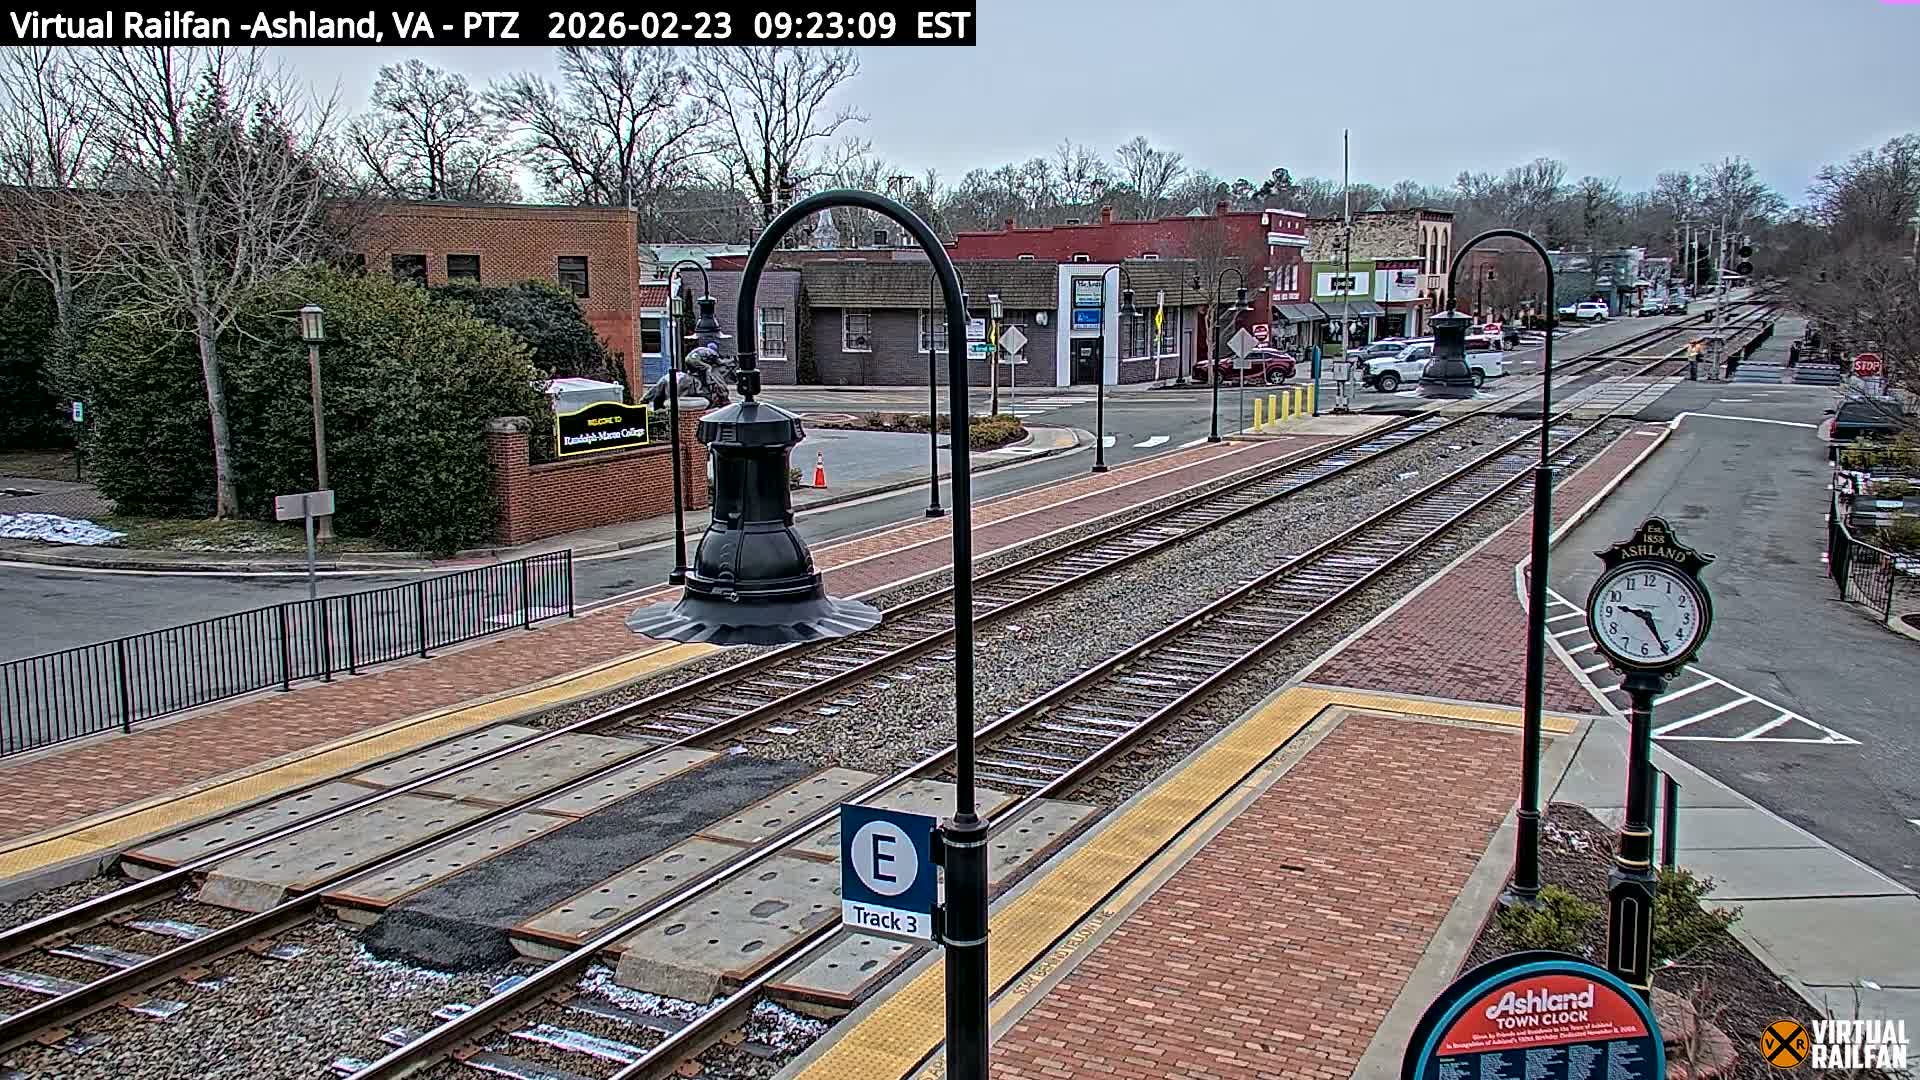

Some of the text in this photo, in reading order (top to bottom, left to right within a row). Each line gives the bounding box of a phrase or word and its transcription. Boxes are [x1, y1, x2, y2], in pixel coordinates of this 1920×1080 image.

[1855, 361, 1880, 371] STOP
[621, 427, 645, 438] College
[1643, 533, 1665, 544] 1858
[1621, 544, 1686, 562] ASHLAND
[1626, 578, 1635, 590] 11
[1644, 575, 1656, 587] 12
[1666, 582, 1672, 594] 1
[1610, 590, 1622, 602] 10
[1678, 595, 1686, 608] 2
[1606, 606, 1612, 617] 9
[1683, 612, 1690, 625] 3
[1609, 622, 1618, 634] 8
[1676, 628, 1684, 640] 4
[1622, 636, 1629, 649] 7
[1641, 643, 1648, 655] 6
[872, 833, 897, 883] E
[853, 905, 917, 933] Track 3
[1485, 984, 1595, 1019] Ashland
[1496, 1010, 1588, 1030] TOWN CLOCK
